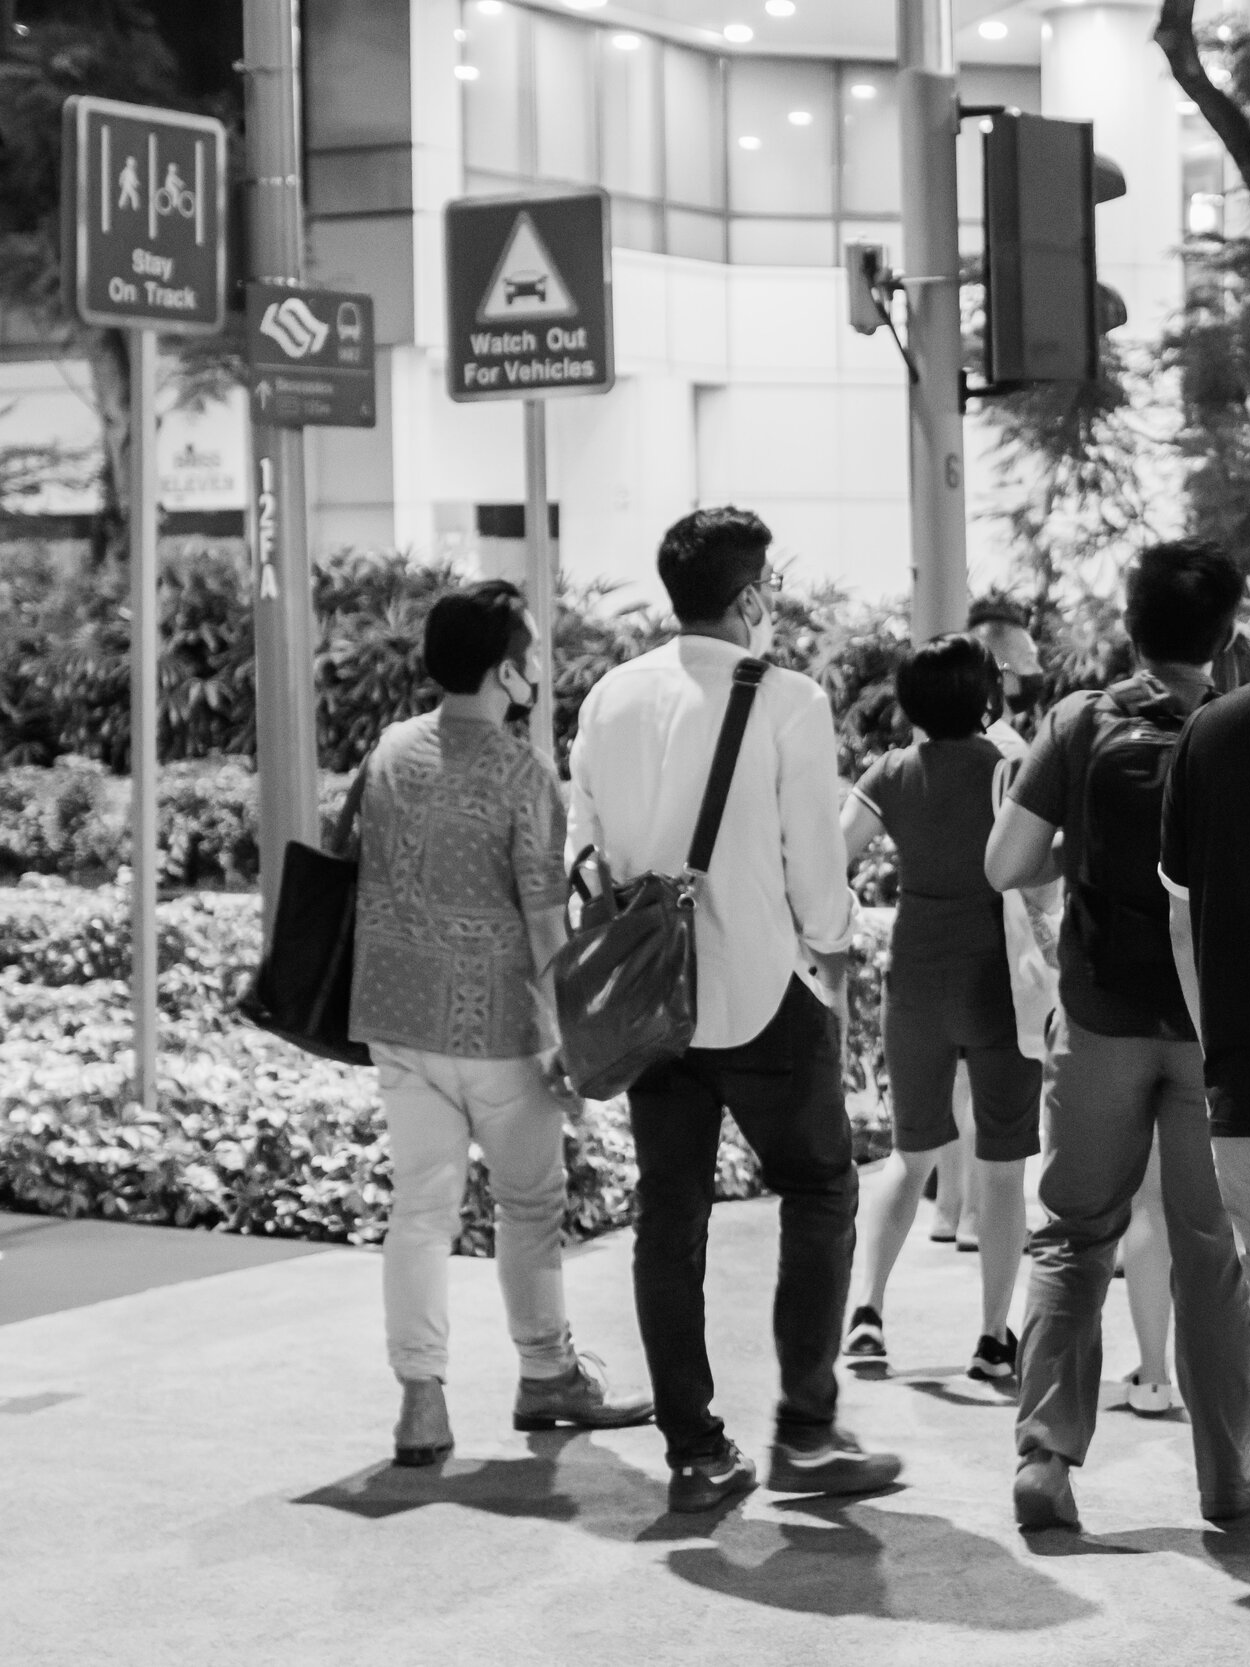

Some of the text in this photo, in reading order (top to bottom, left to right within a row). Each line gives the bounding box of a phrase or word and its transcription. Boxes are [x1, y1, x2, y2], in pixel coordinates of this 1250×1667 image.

[132, 248, 172, 282] Stay
[108, 276, 197, 310] On Track
[470, 326, 586, 356] Watch Out
[463, 356, 595, 386] For Vehicles
